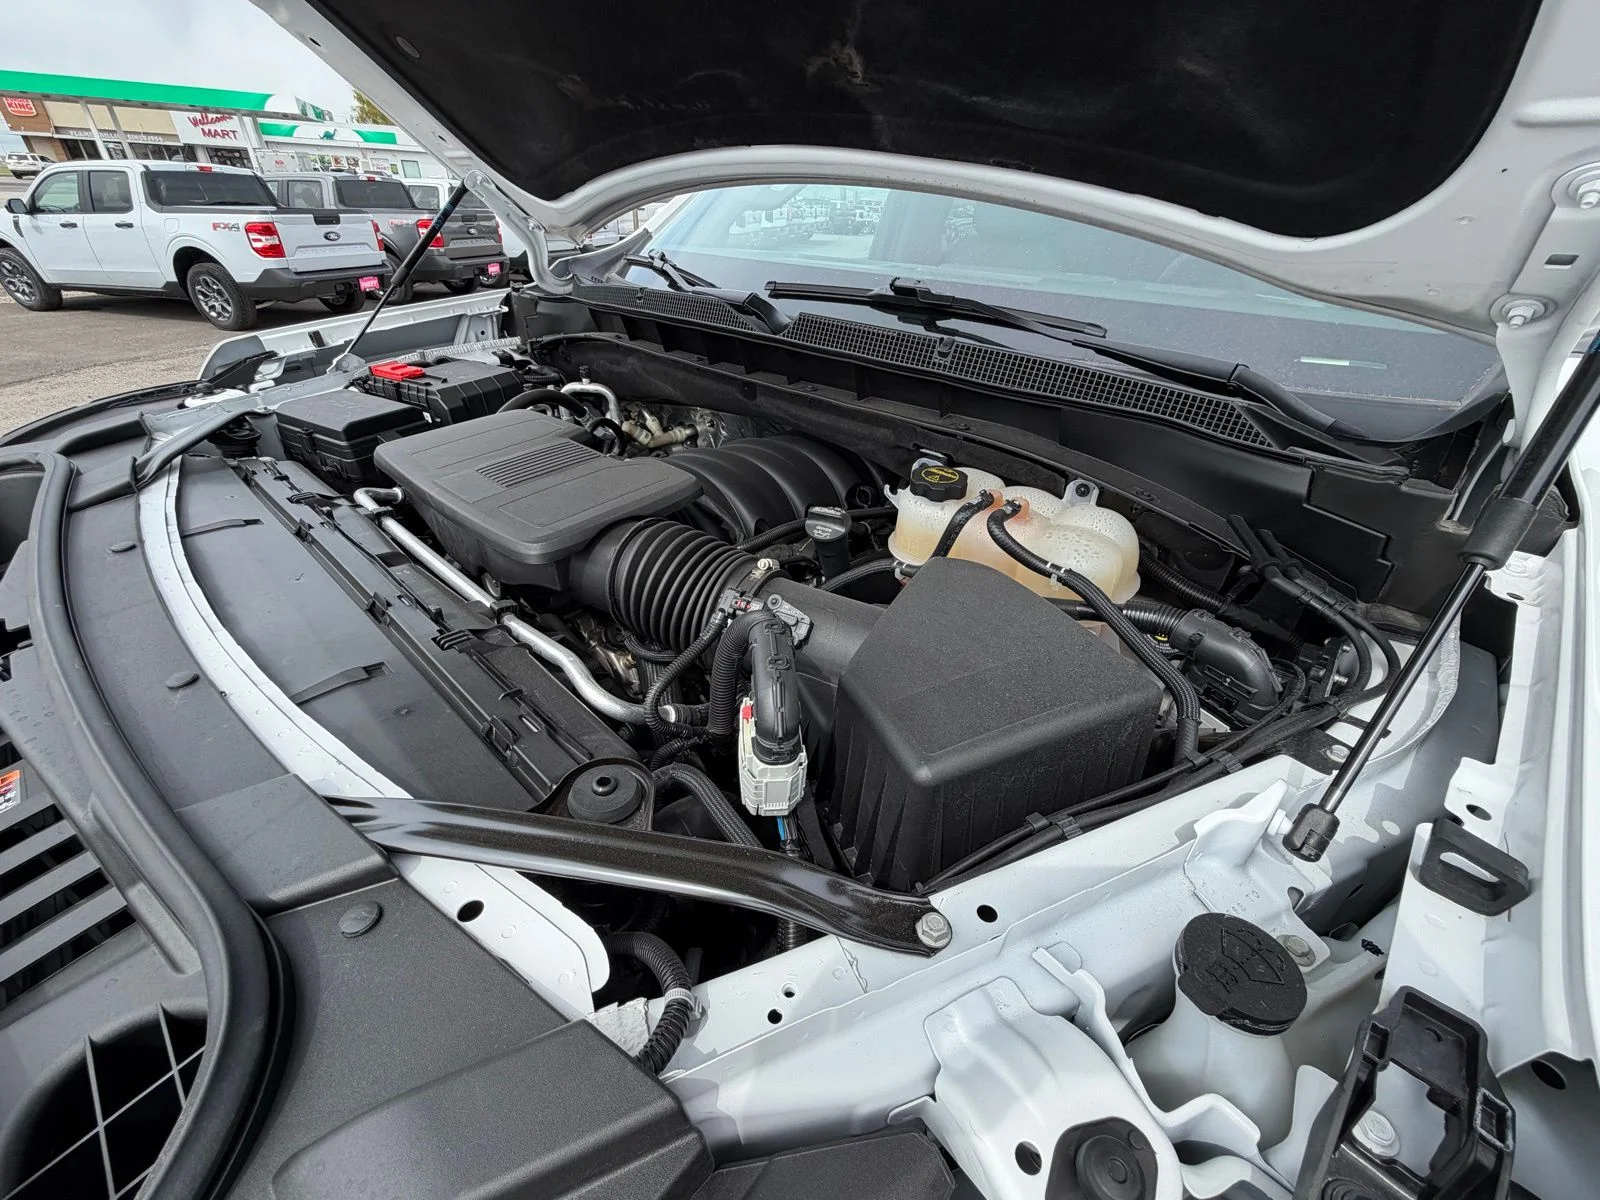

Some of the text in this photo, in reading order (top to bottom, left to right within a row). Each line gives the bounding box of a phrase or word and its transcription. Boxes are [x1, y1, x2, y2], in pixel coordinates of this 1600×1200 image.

[7, 101, 33, 110] KING
[201, 127, 238, 140] MART
[211, 222, 240, 231] FX4
